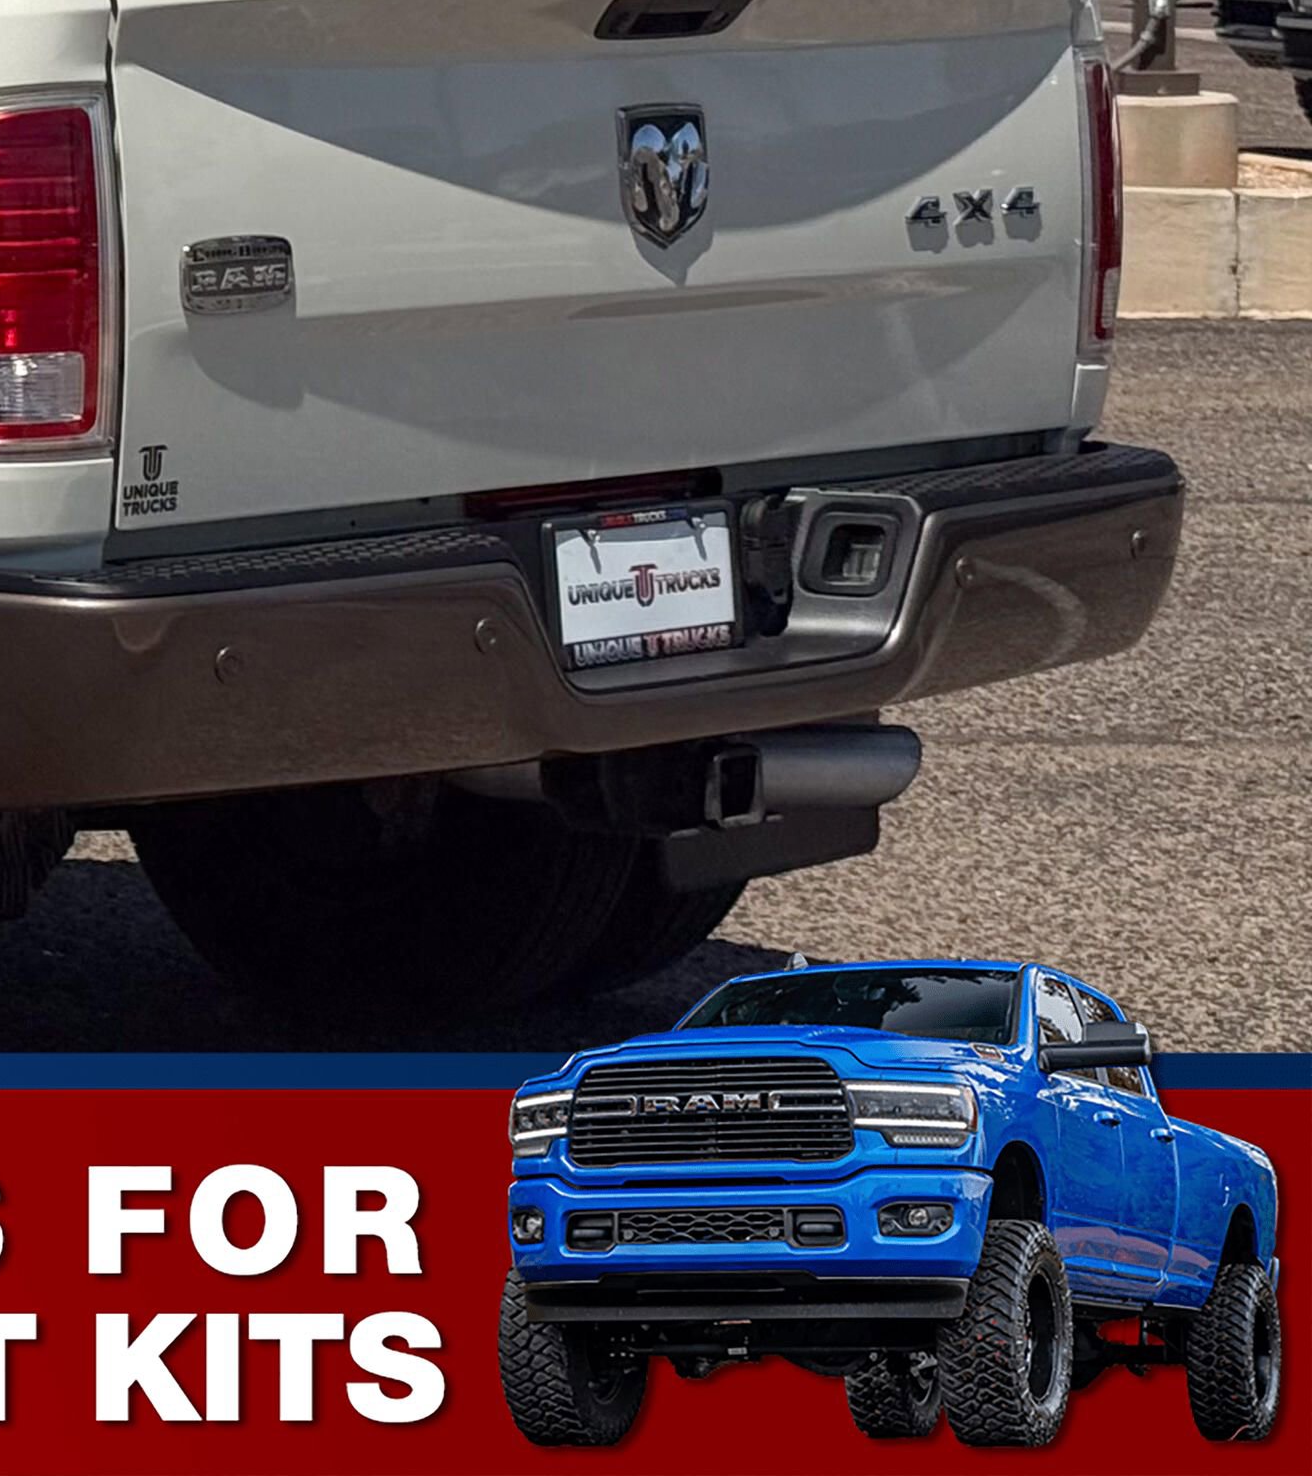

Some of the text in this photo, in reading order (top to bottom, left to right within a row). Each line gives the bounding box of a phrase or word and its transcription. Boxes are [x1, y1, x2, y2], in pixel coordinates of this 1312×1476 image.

[191, 264, 286, 292] RAM
[123, 481, 179, 500] UNIQUE
[123, 498, 177, 516] TRUCKS
[568, 579, 634, 606] UNIQUE
[655, 568, 721, 595] TRUCKS
[574, 636, 642, 667] UNIQUE
[662, 625, 731, 654] TRUCKS
